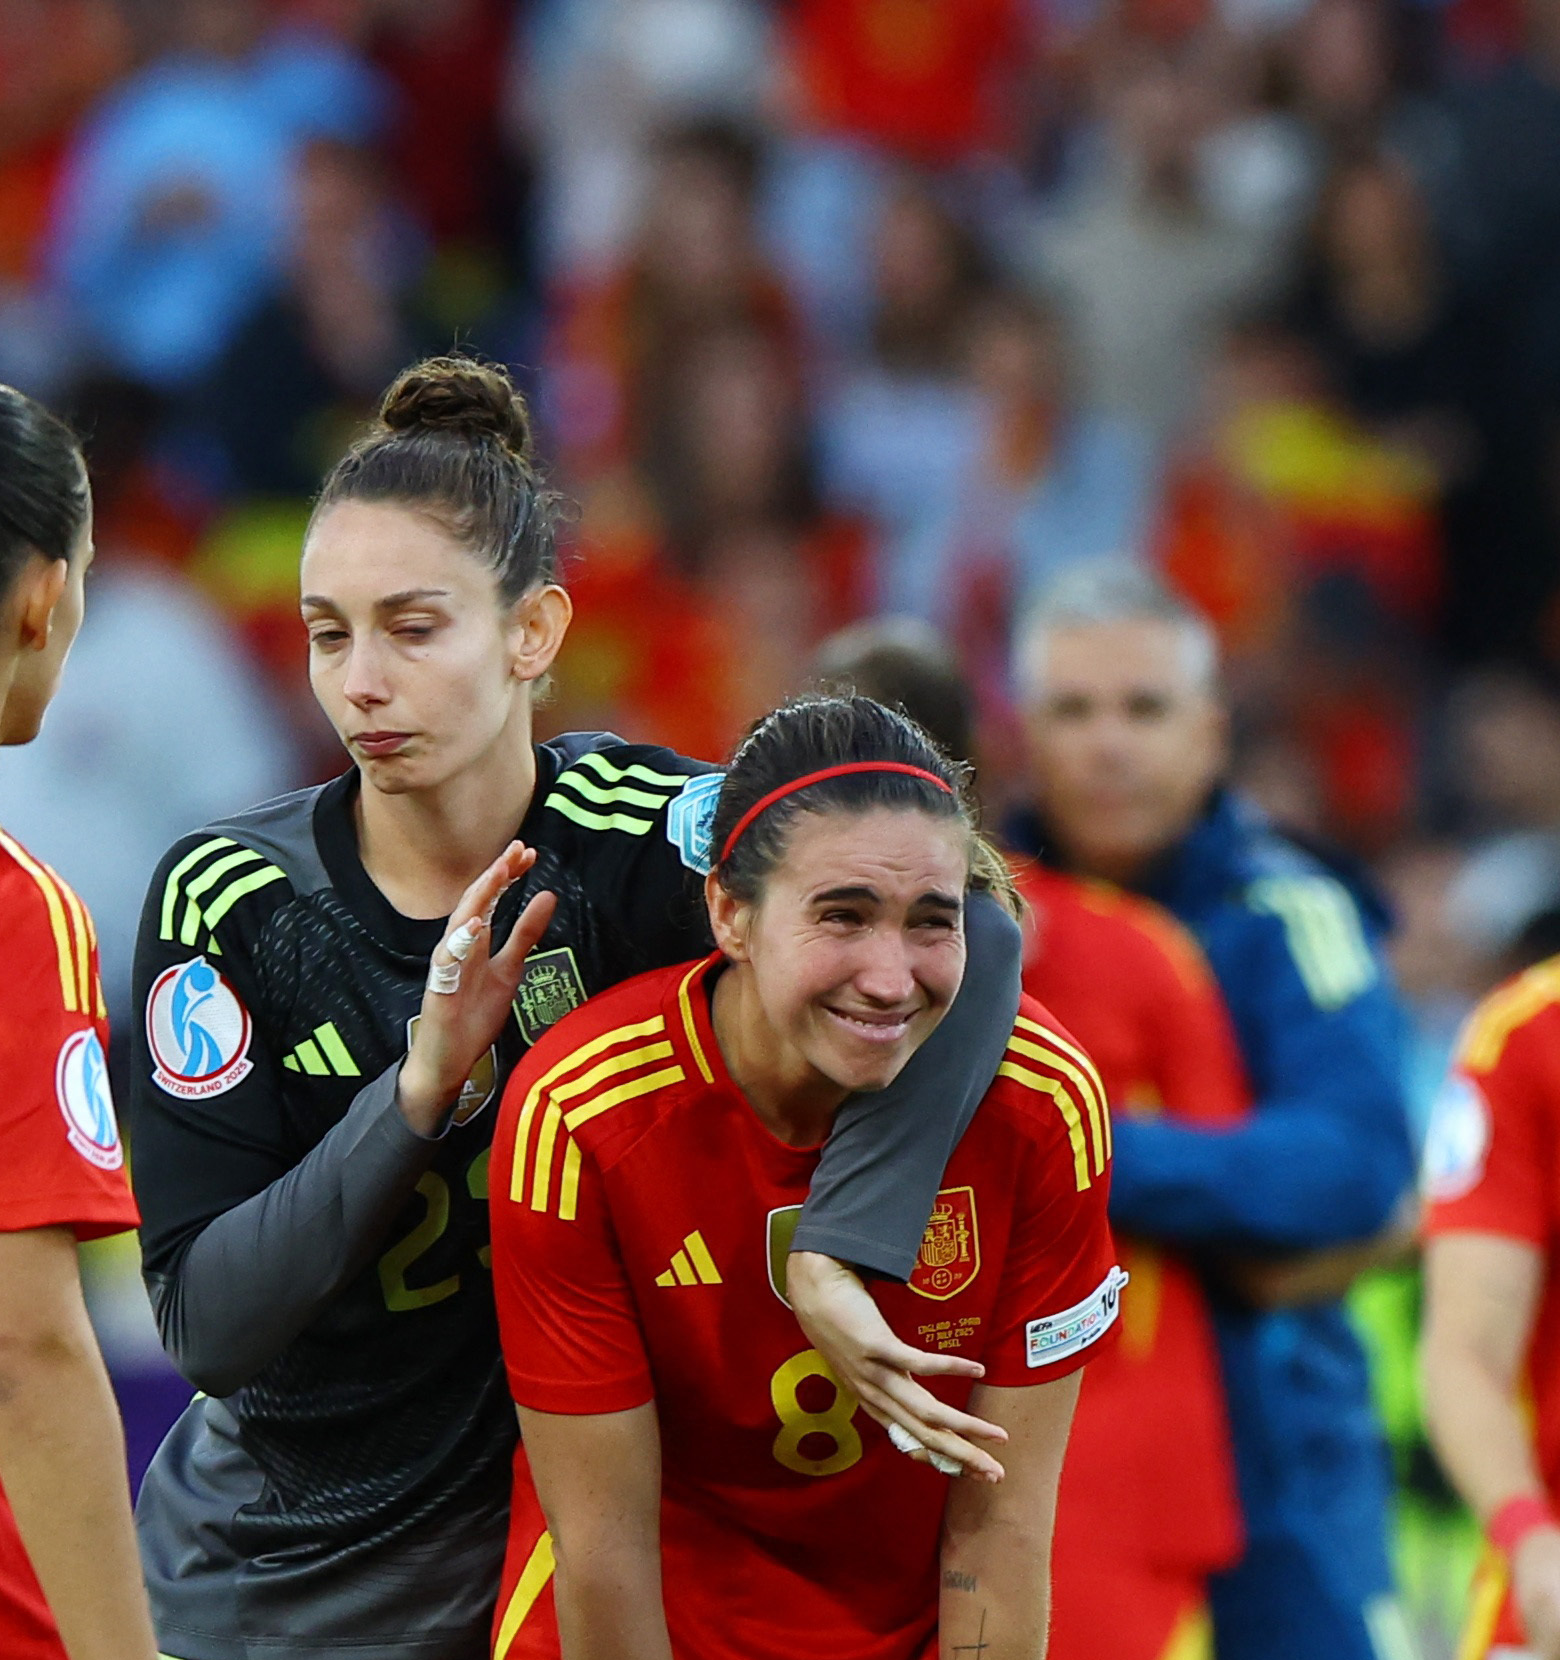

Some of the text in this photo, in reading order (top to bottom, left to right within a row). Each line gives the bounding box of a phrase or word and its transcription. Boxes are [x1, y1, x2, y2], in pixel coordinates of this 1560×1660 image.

[156, 1060, 248, 1096] SWITZERLAND 2025
[771, 1348, 862, 1476] 8
